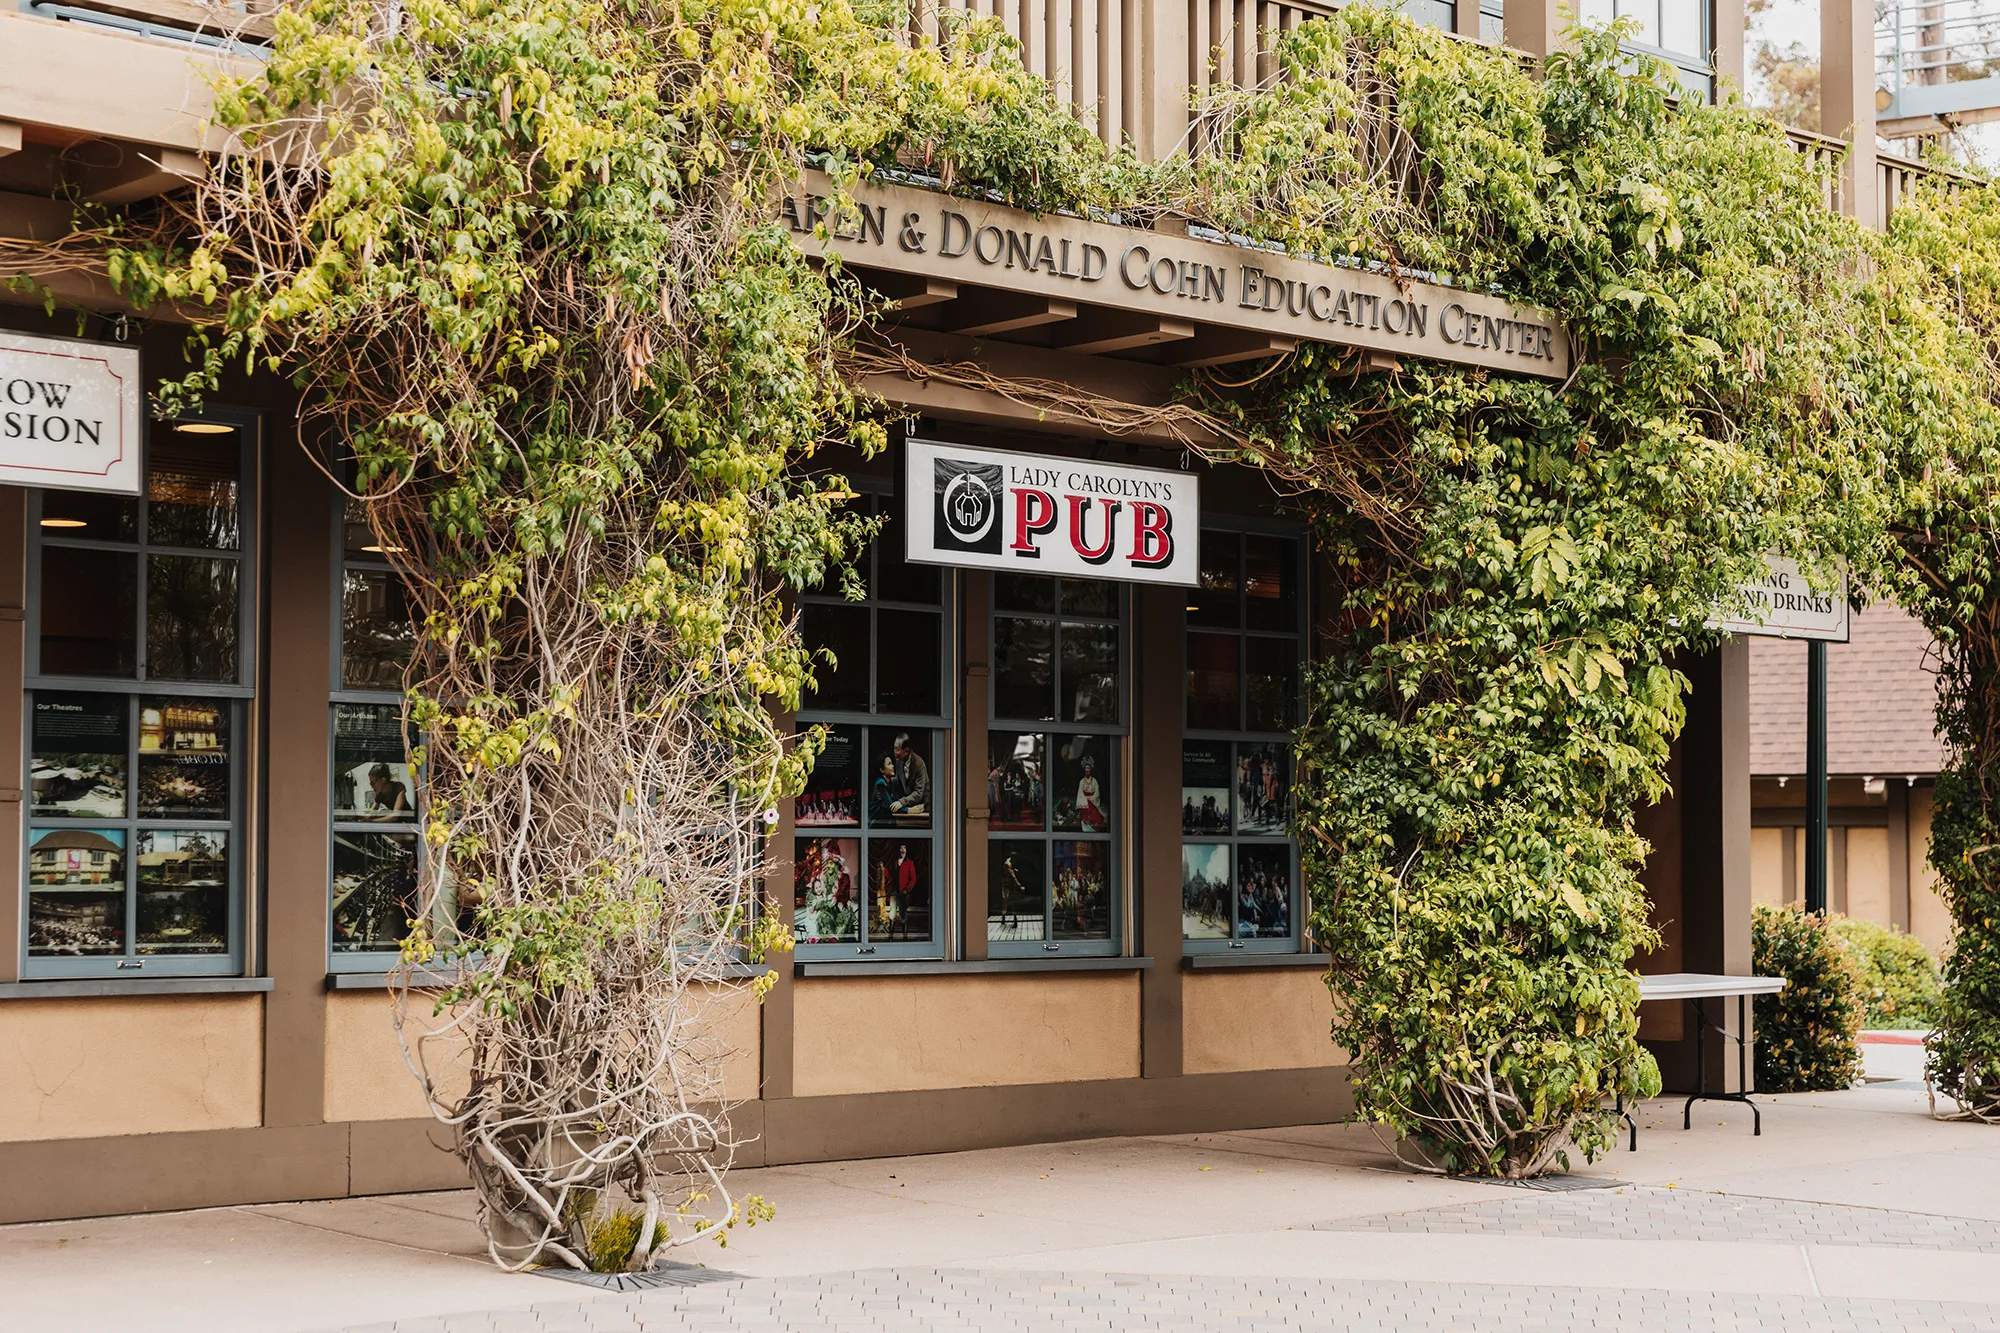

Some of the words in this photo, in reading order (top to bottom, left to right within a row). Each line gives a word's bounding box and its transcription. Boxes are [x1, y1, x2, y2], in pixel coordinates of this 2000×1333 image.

[775, 193, 887, 245] AREN
[899, 211, 928, 254] &
[938, 208, 1108, 282] DONALD
[1119, 244, 1227, 303] COHN
[1237, 264, 1428, 338] EDUCATION
[1439, 302, 1554, 361] CENTER
[0, 377, 71, 409] OW
[1010, 466, 1061, 488] LADY
[1068, 472, 1172, 502] CAROLYN'S
[1009, 487, 1175, 570] PUB
[1773, 592, 1832, 614] DRINKS
[52, 703, 83, 711] Theatres
